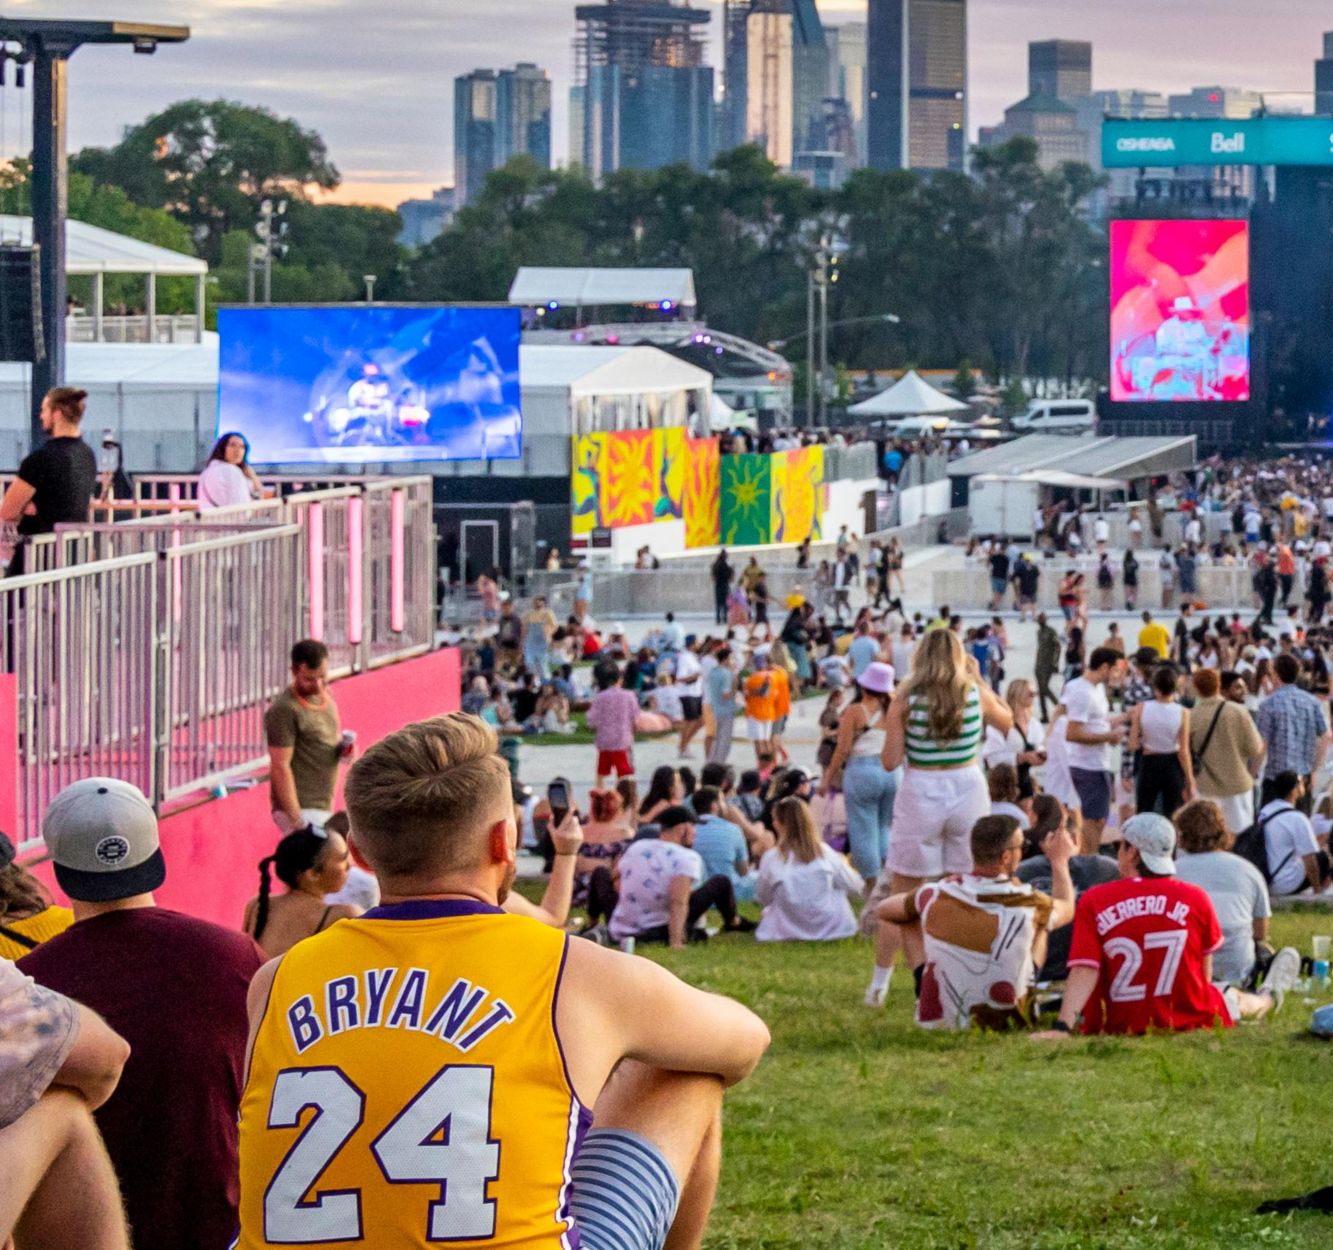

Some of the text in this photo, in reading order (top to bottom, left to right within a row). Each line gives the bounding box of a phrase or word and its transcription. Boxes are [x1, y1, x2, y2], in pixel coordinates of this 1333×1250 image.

[1211, 132, 1245, 153] Bell
[1103, 928, 1188, 1003] 27
[287, 967, 516, 1055] BRYANT
[263, 1063, 501, 1244] 24
